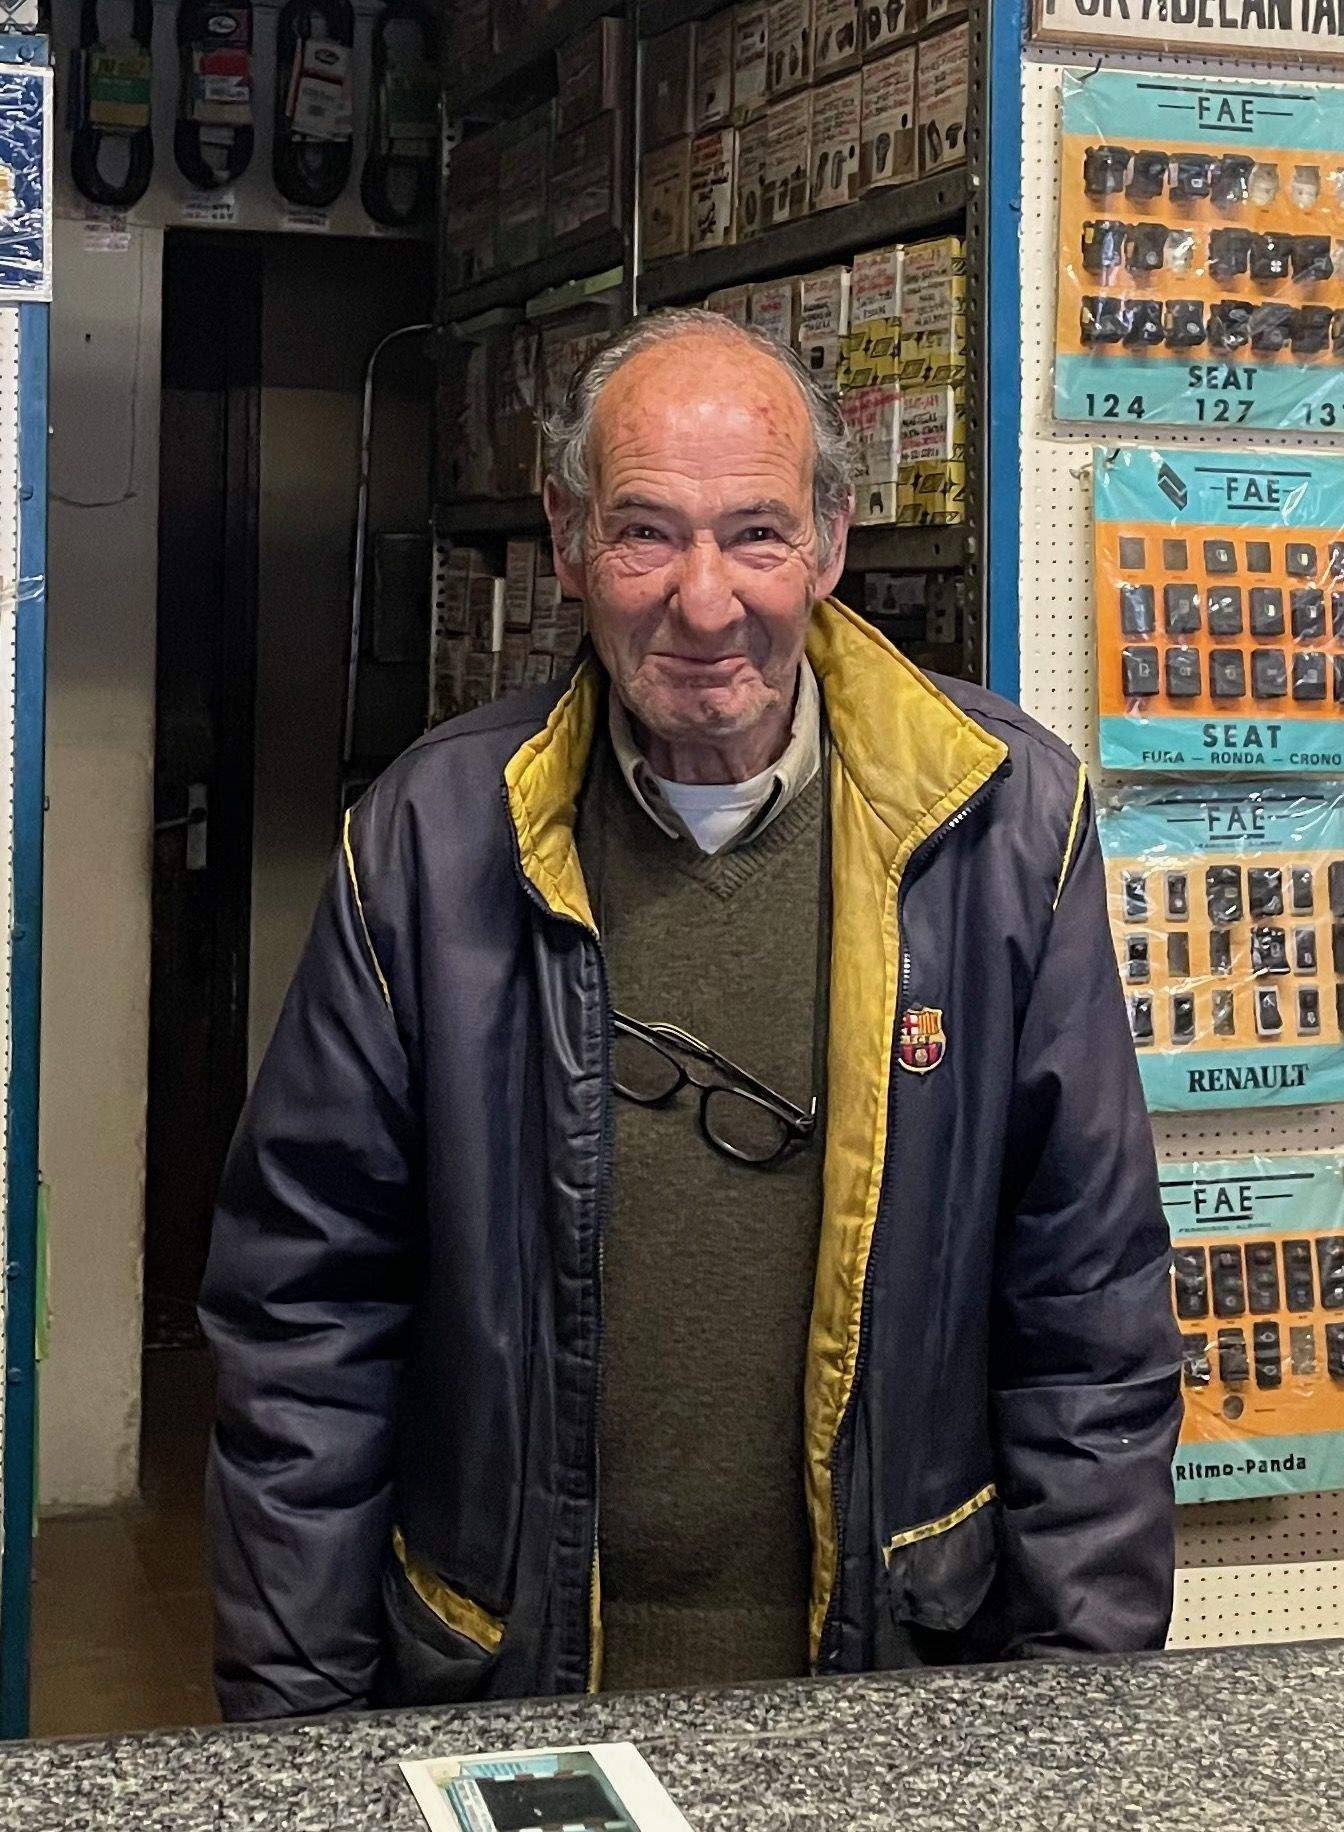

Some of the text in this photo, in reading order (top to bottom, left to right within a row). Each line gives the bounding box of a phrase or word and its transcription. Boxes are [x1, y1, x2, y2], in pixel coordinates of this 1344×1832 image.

[1198, 97, 1254, 124] FAE
[1188, 364, 1258, 391] SEAT
[1085, 393, 1145, 419] 124
[1196, 398, 1254, 423] 127
[1226, 477, 1281, 503] FAE
[1202, 724, 1281, 749] SEAT
[1142, 751, 1342, 766] FURA RONDA CRONO
[1208, 804, 1264, 831] FAE
[1187, 1063, 1310, 1093] RENAULT
[1194, 1185, 1253, 1214] FAE
[1175, 1453, 1306, 1481] Ritmo-Panda
